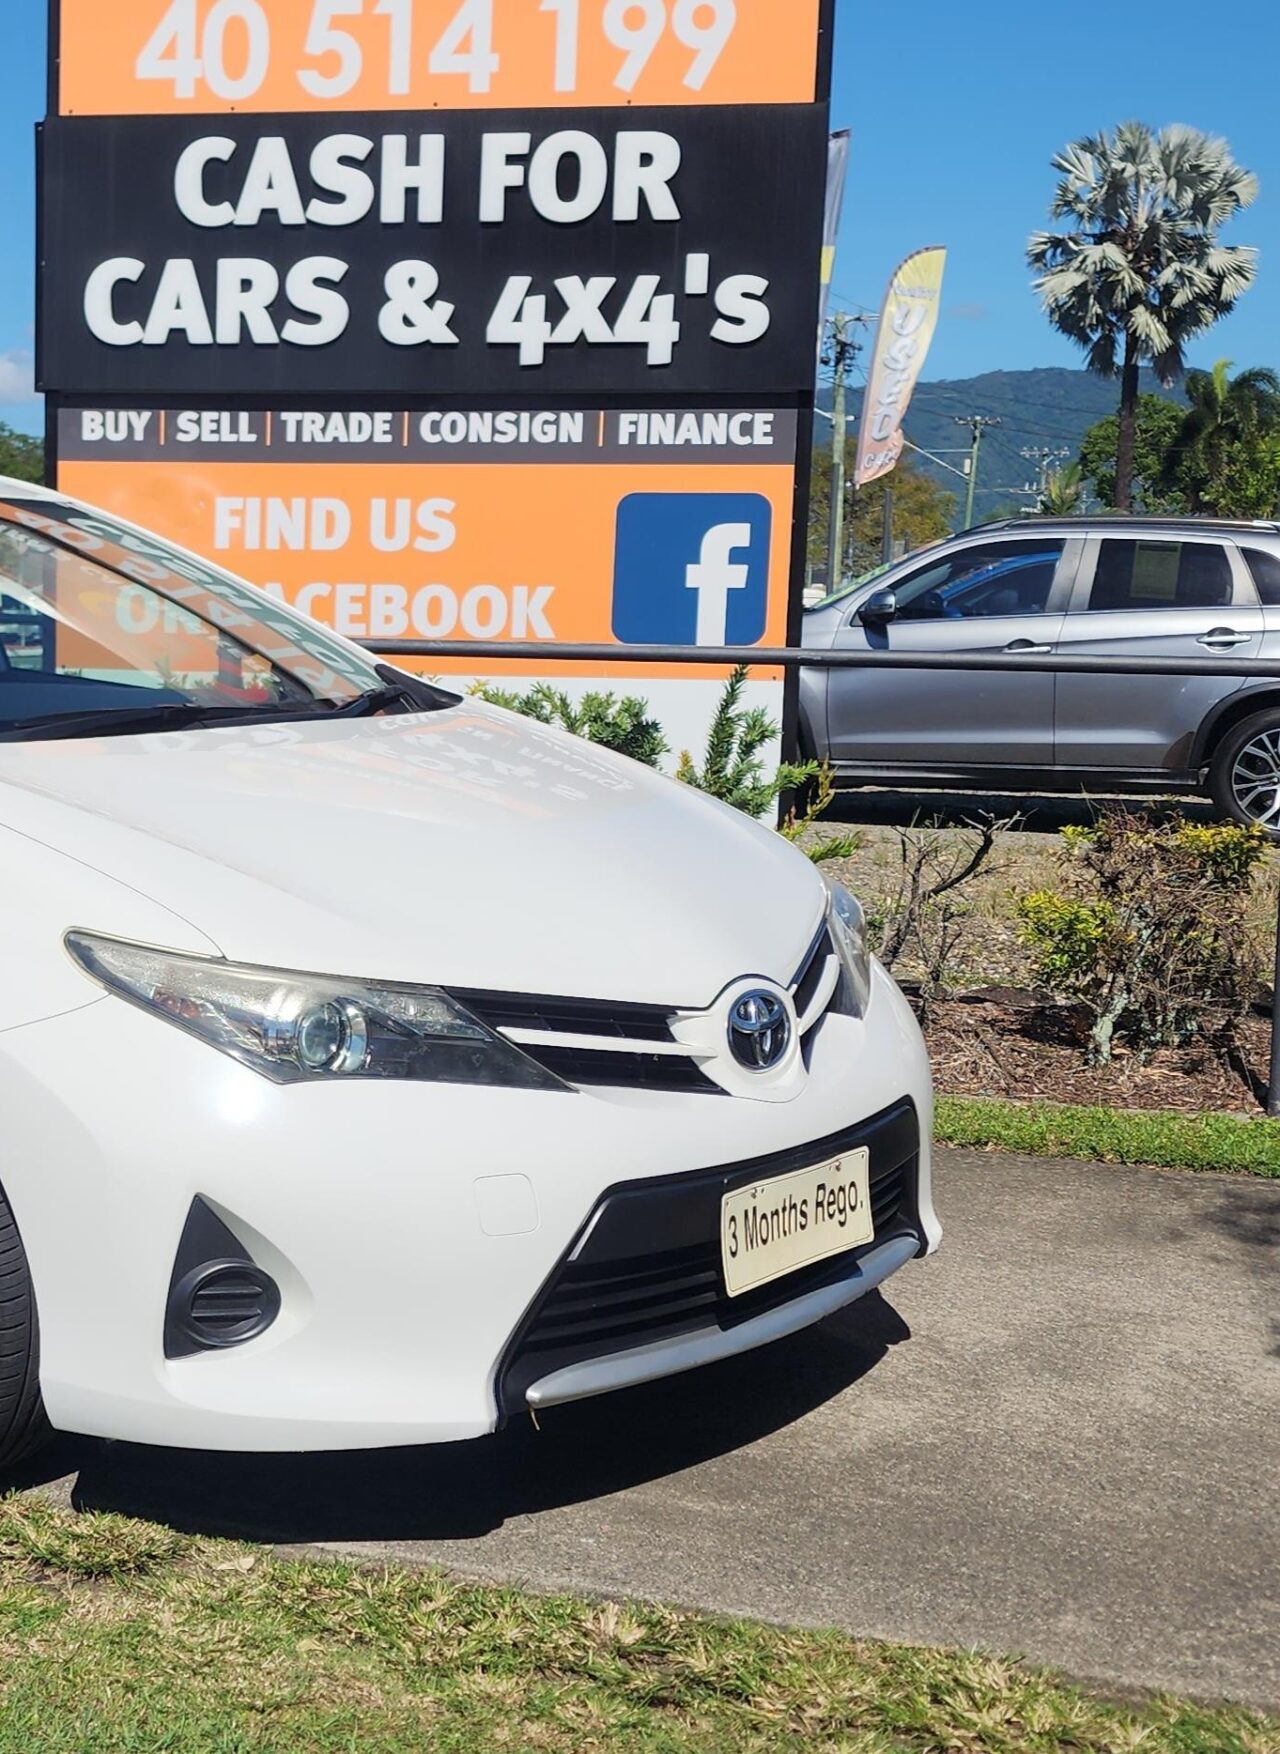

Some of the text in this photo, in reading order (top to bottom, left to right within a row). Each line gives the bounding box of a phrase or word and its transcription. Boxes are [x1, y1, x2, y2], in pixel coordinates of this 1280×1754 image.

[135, 0, 737, 100] 40 514 199
[174, 130, 681, 228] CASH FOR
[83, 256, 350, 346] CARS
[377, 259, 459, 345] &
[81, 410, 775, 446] BUY SELL TRADE CONSIGN FINANCE
[214, 496, 457, 553] FIND US
[728, 1180, 864, 1258] 3 Months Rego.
